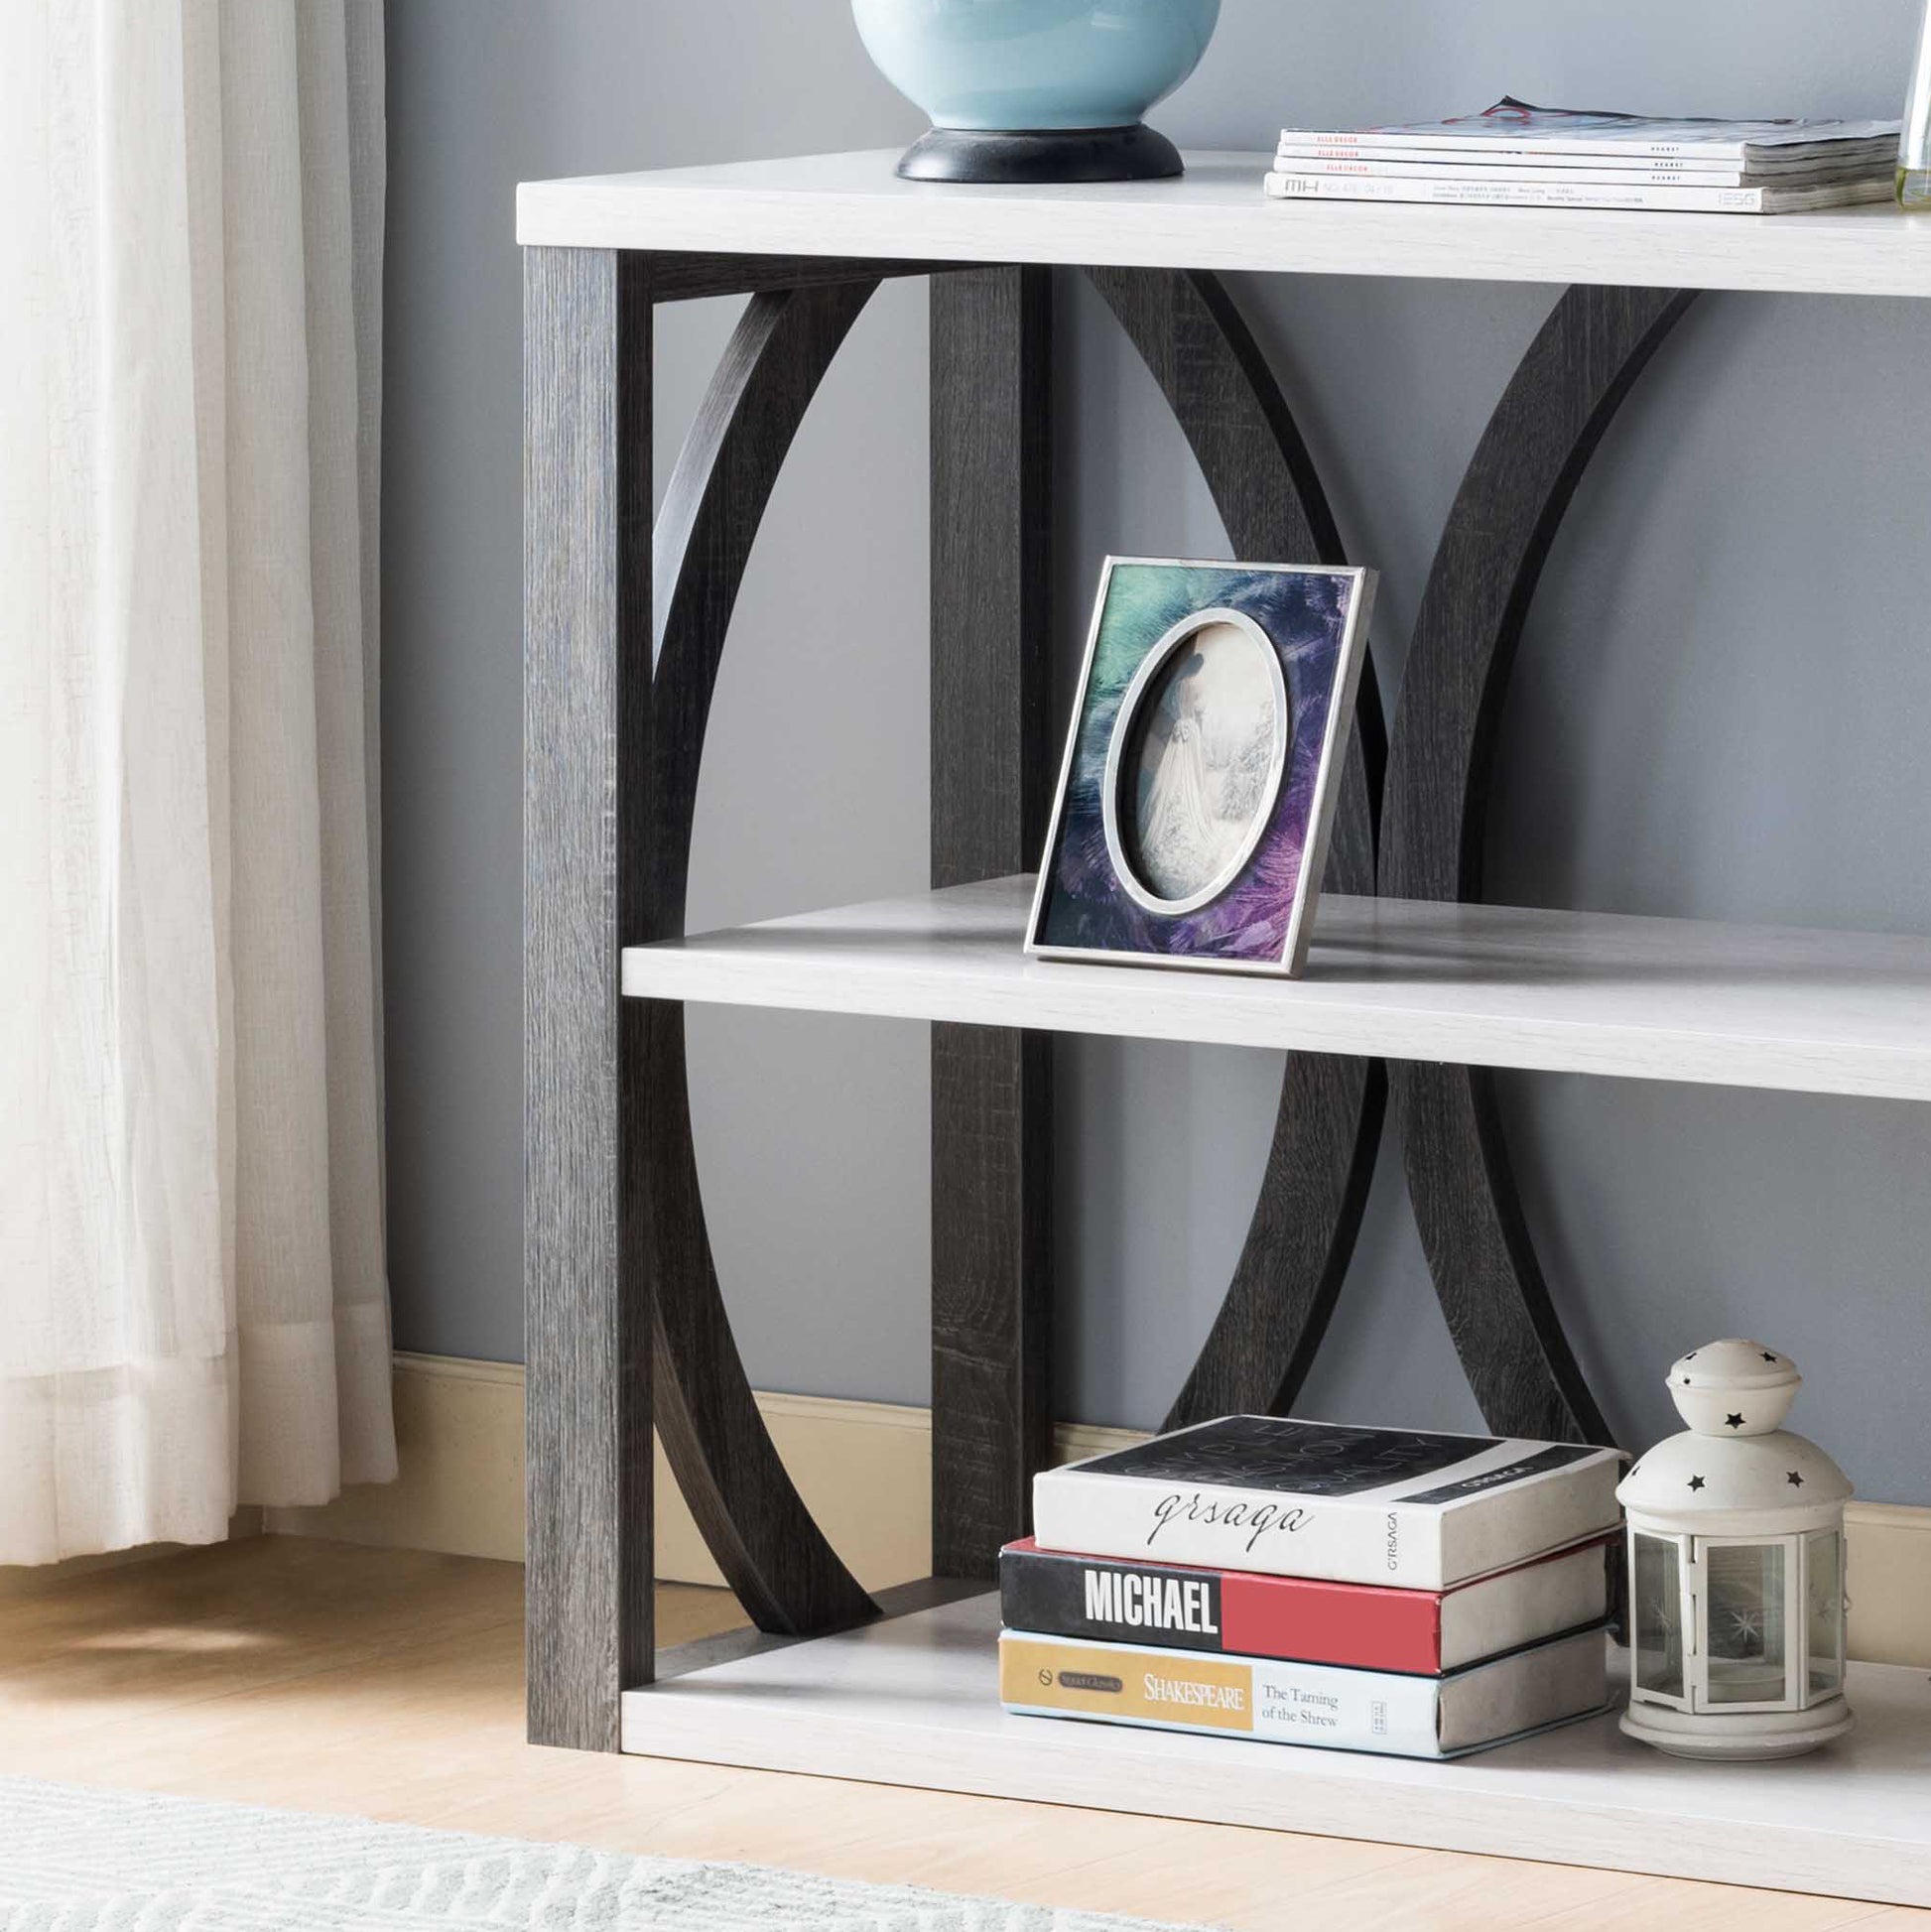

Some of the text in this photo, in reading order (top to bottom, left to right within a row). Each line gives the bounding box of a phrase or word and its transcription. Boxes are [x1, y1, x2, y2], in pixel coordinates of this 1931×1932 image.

[1085, 1569, 1219, 1634] MICHAEL
[1143, 1673, 1245, 1711] SHAKESPEARE
[1263, 1684, 1339, 1711] The Taming
[1262, 1707, 1340, 1728] of the Shrew
